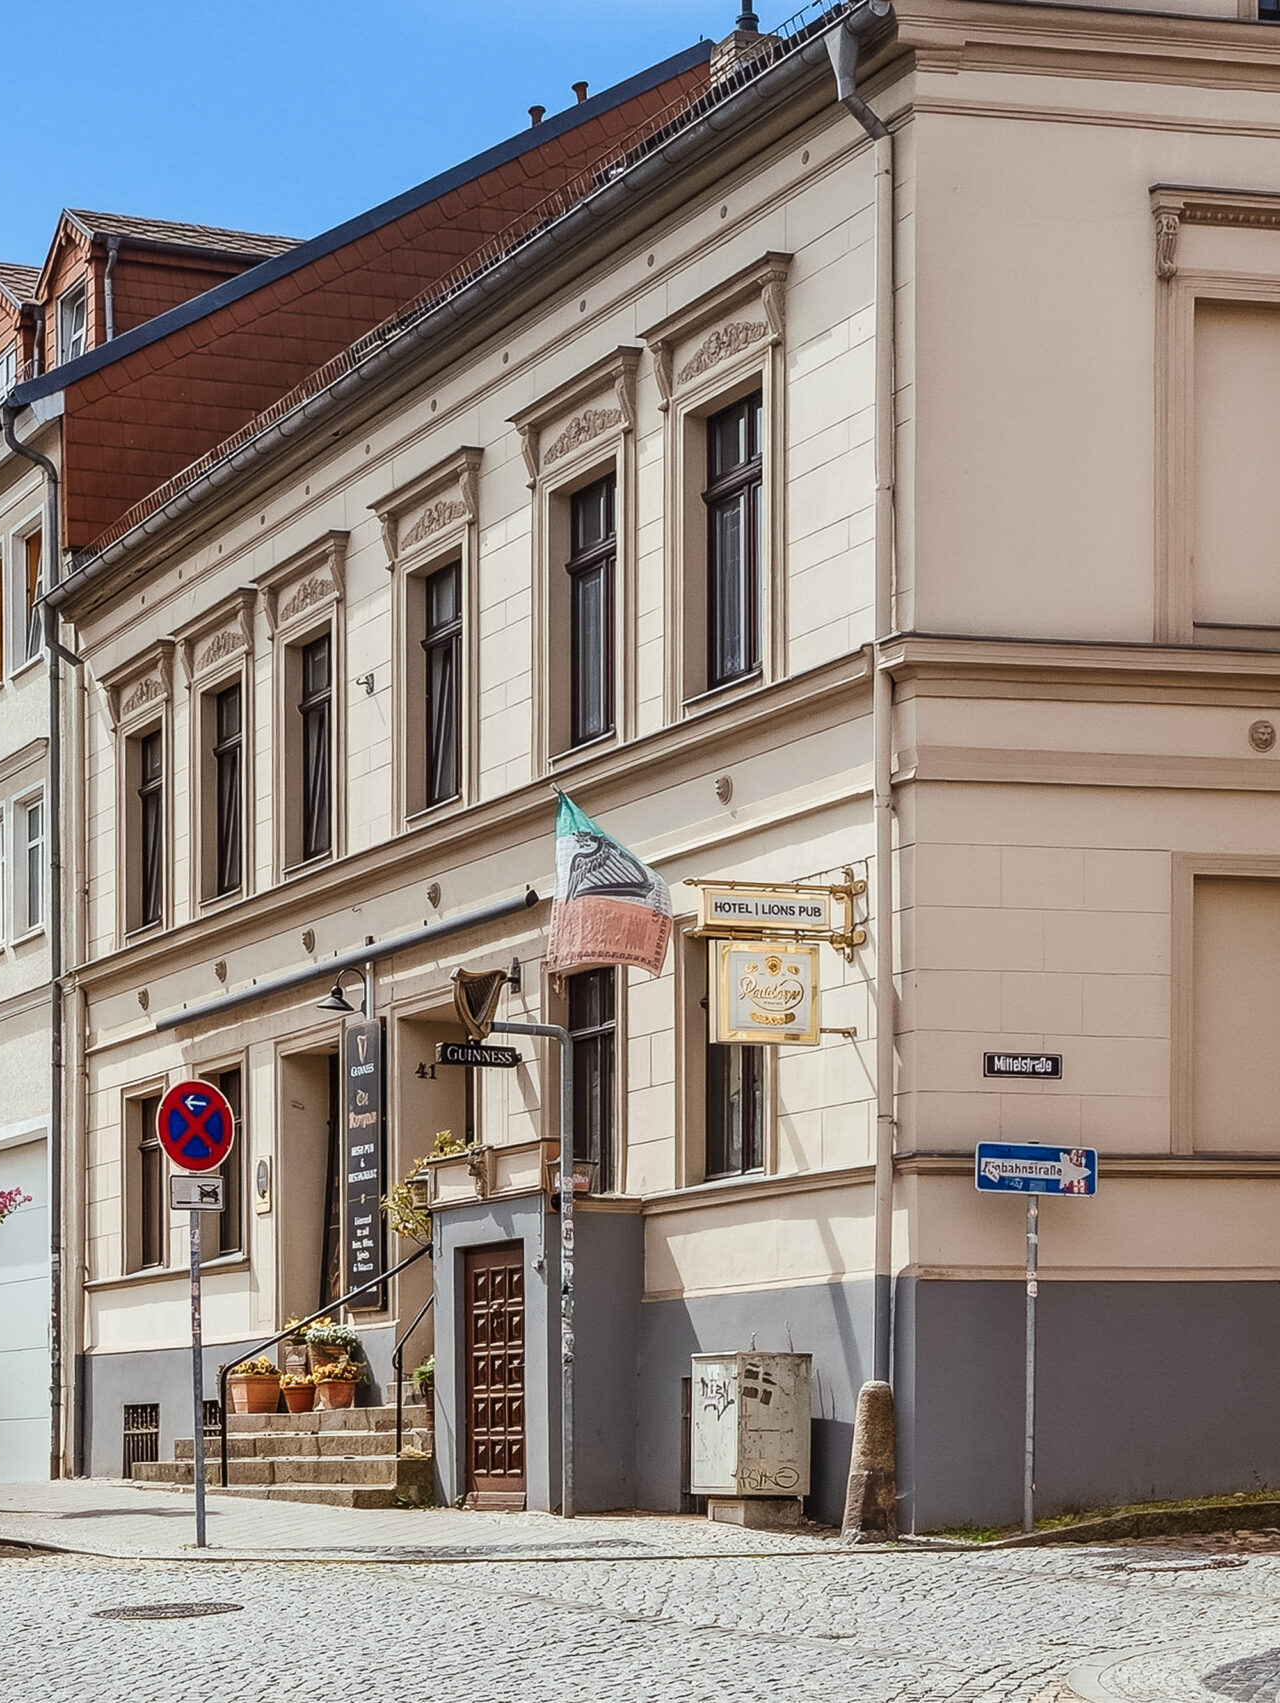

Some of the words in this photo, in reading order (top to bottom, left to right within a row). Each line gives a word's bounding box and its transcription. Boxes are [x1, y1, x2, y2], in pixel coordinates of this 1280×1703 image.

[714, 901, 752, 915] HOTEL
[761, 903, 796, 916] LIONS
[798, 905, 822, 917] PUB
[446, 1045, 513, 1064] GUINNESS
[415, 1062, 437, 1079] 41
[994, 1056, 1052, 1073] Mittelstraße
